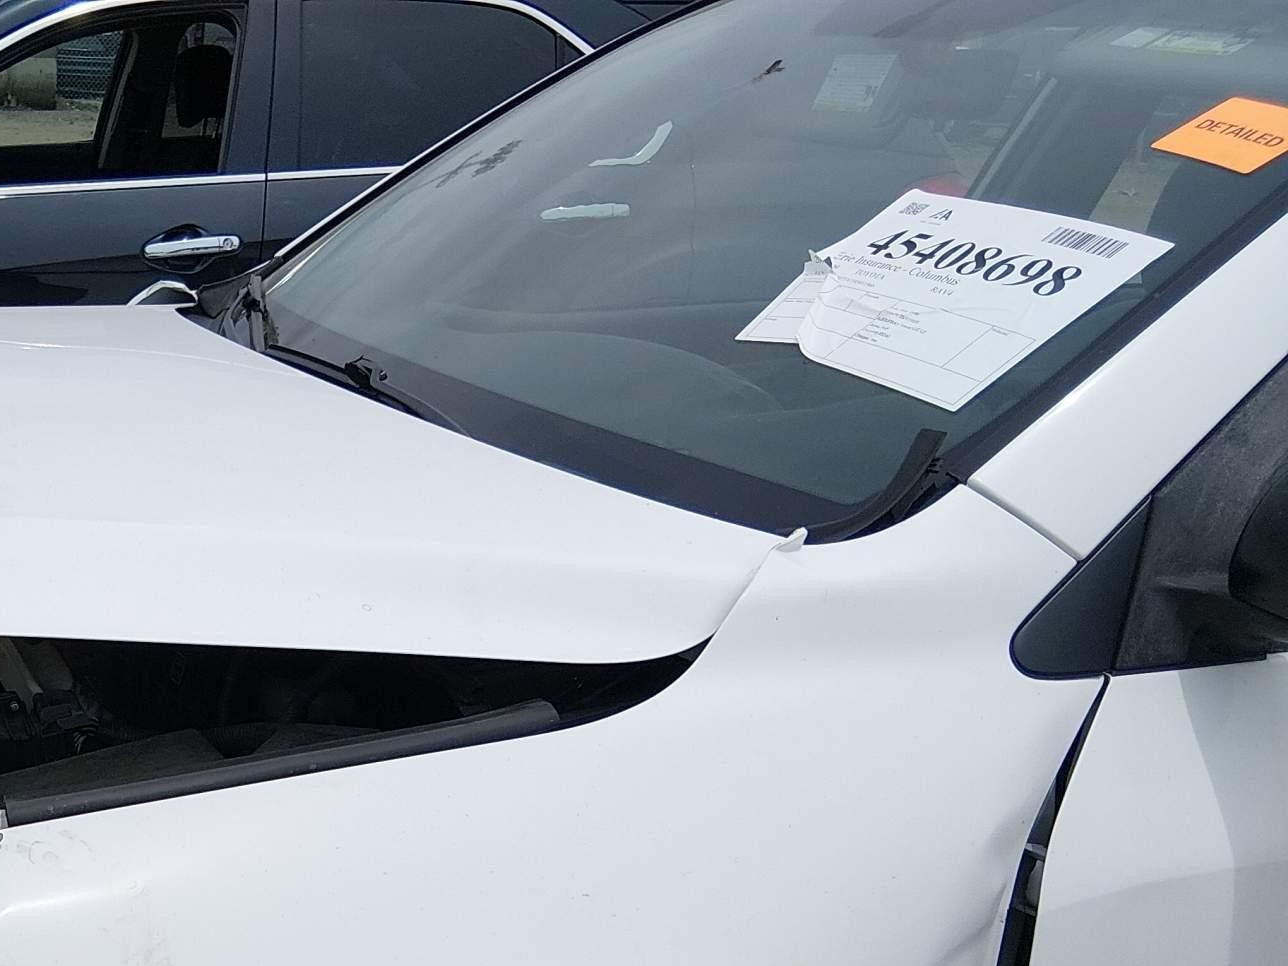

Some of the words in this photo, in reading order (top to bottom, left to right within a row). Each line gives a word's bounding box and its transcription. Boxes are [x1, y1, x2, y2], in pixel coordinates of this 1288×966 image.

[1194, 118, 1285, 148] DETAILED
[855, 256, 902, 273] Insurance
[908, 266, 960, 287] Columbus
[867, 230, 1082, 297] 45408698
